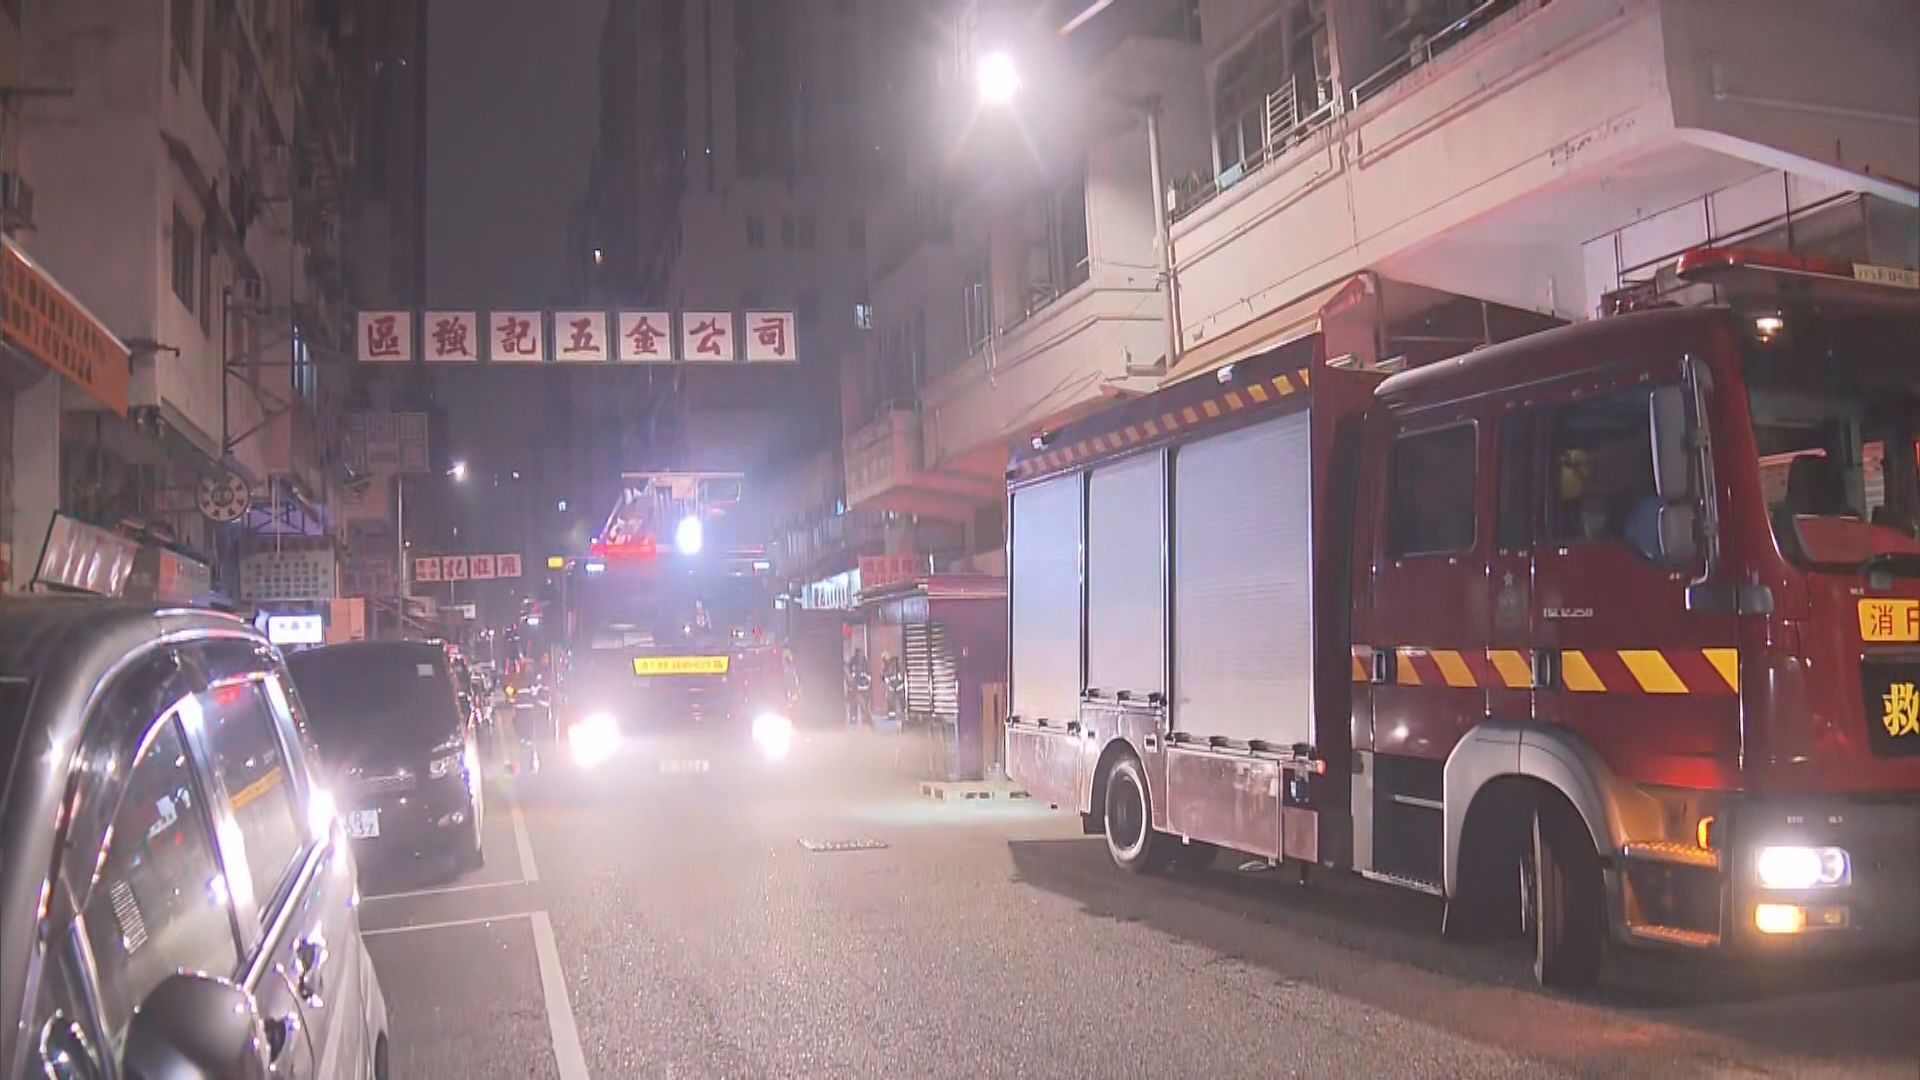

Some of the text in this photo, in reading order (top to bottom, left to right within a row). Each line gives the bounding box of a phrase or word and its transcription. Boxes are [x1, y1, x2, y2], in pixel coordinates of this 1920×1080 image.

[368, 316, 787, 358] 區強記五金公司
